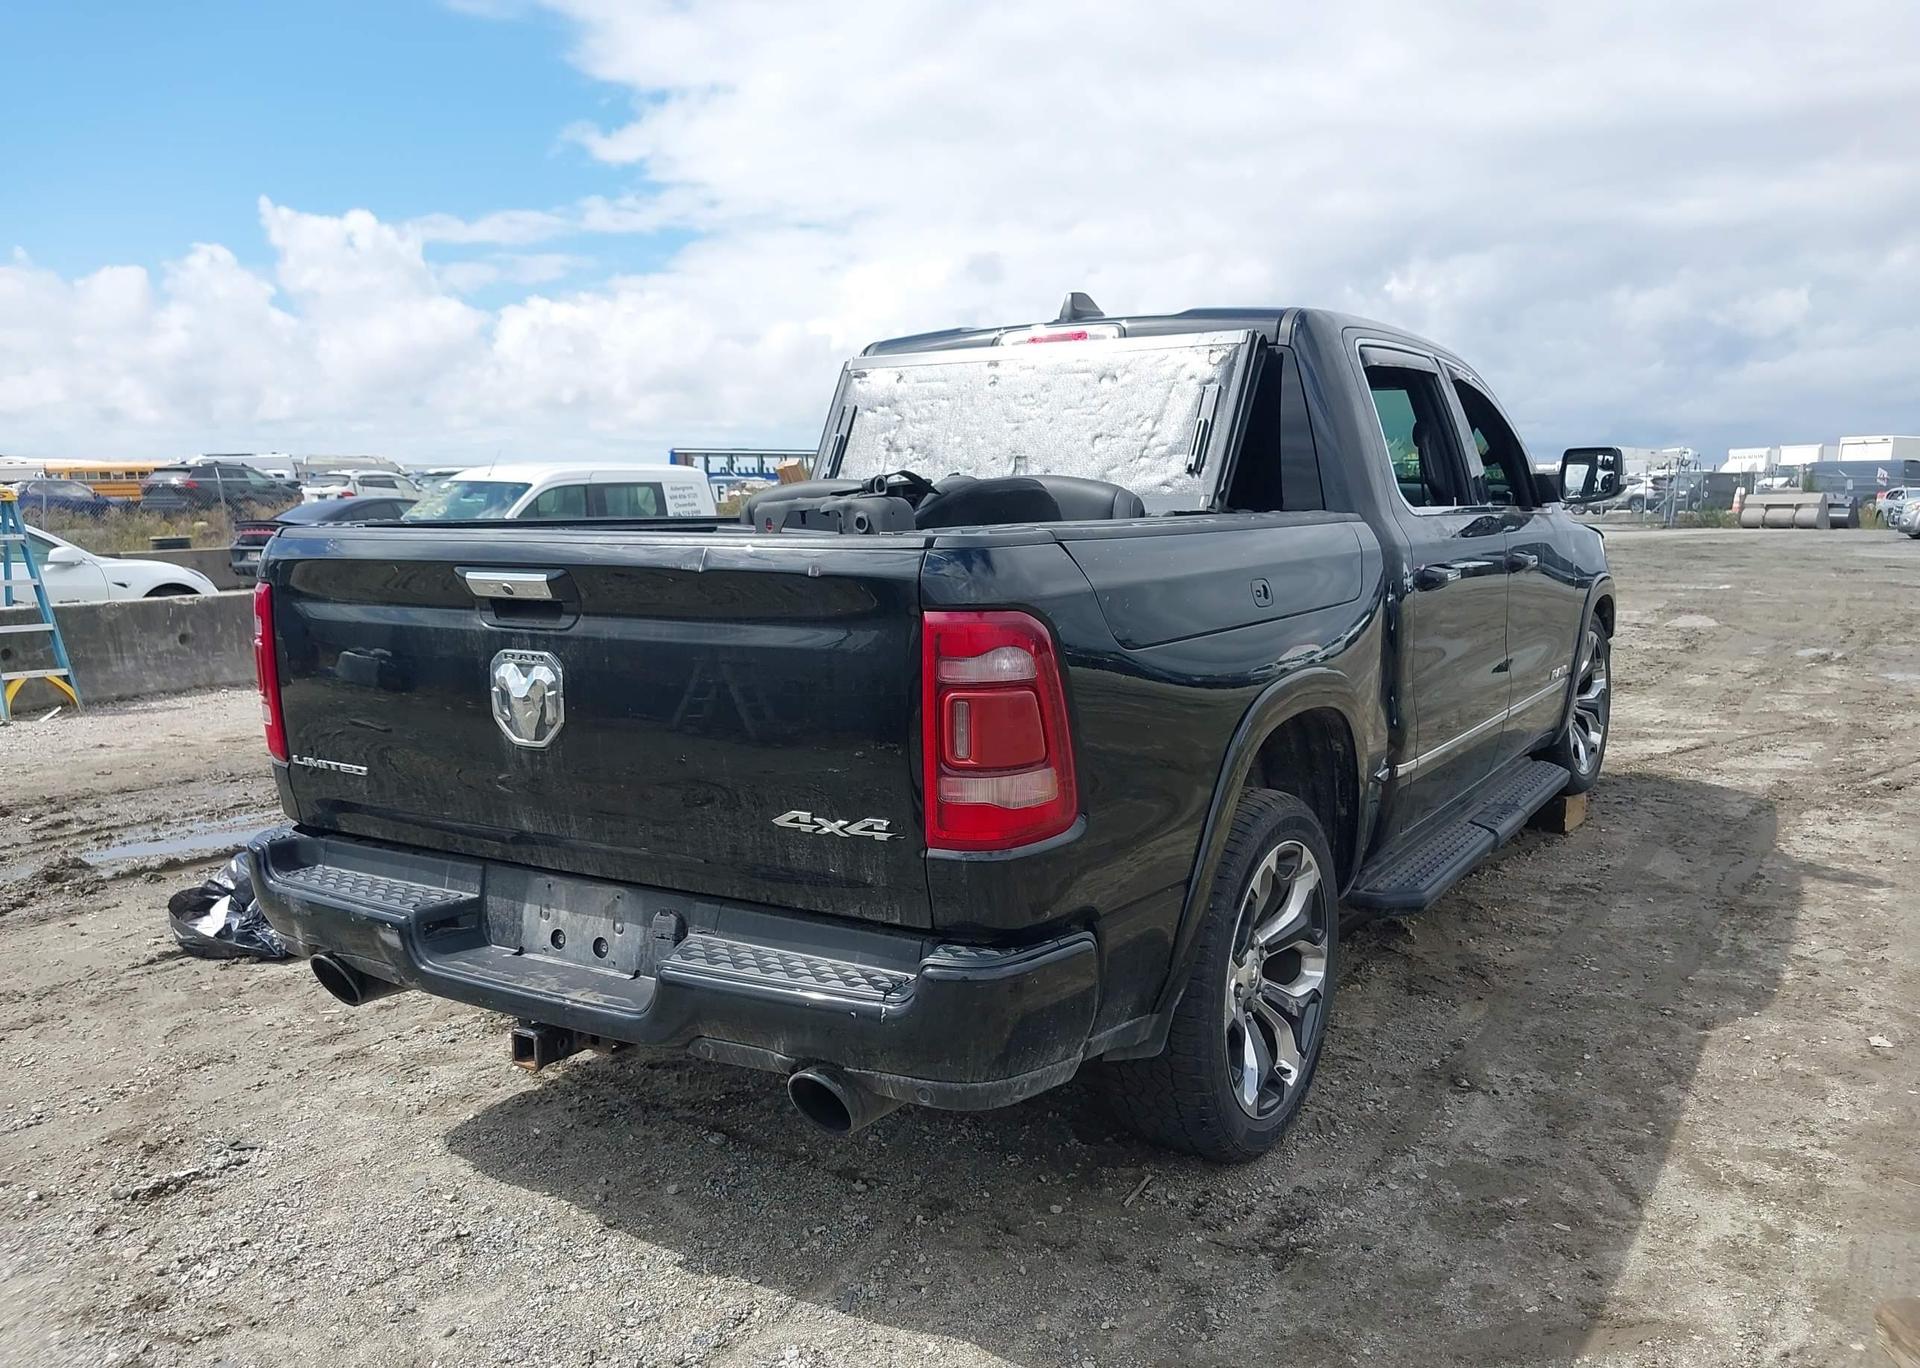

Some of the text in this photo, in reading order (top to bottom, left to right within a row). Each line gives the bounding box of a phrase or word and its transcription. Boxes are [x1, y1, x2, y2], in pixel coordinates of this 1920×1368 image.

[717, 485, 724, 501] F
[503, 653, 545, 663] RAM
[292, 754, 369, 776] LIMITED
